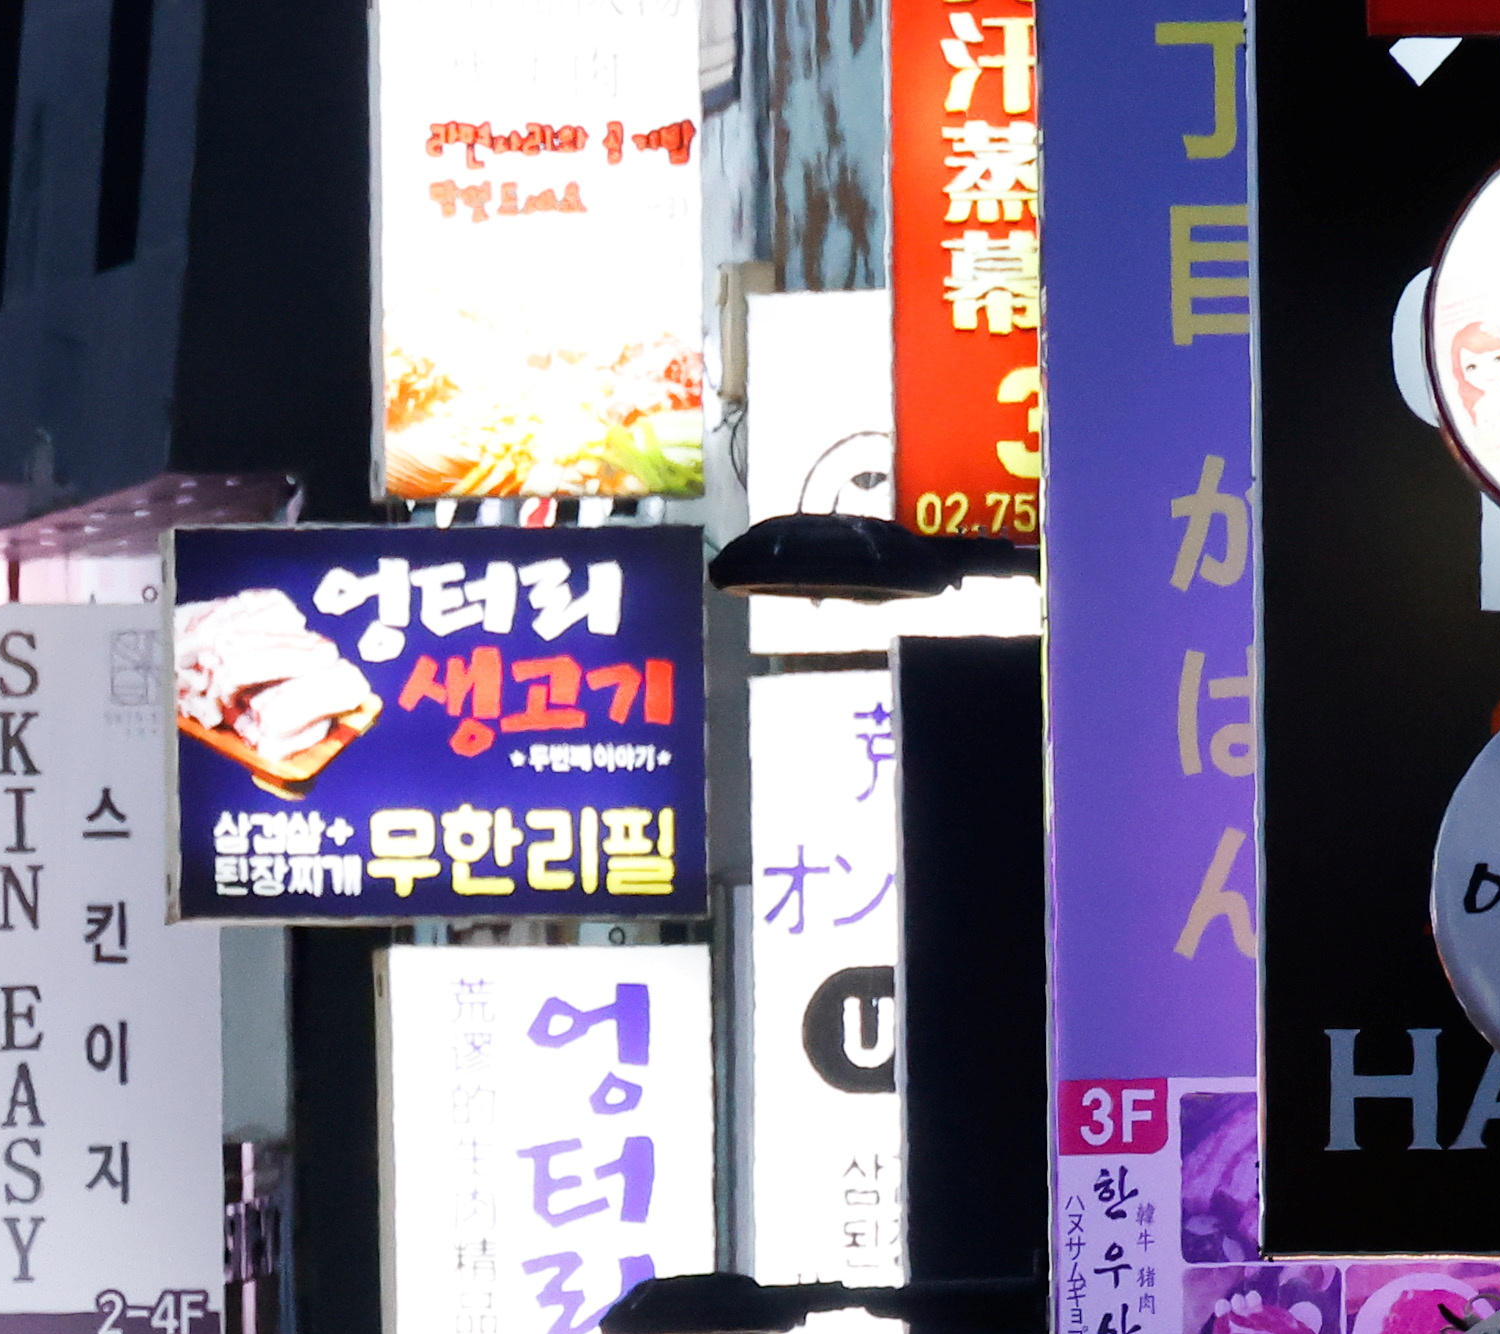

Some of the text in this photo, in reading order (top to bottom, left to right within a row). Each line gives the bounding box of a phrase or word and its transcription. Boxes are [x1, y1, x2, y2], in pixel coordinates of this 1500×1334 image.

[312, 558, 624, 663] 엉터리
[398, 647, 675, 757] 생고기
[367, 806, 678, 899] 무한리필
[81, 785, 133, 1208] 스킨이지
[1078, 1086, 1156, 1148] 3F
